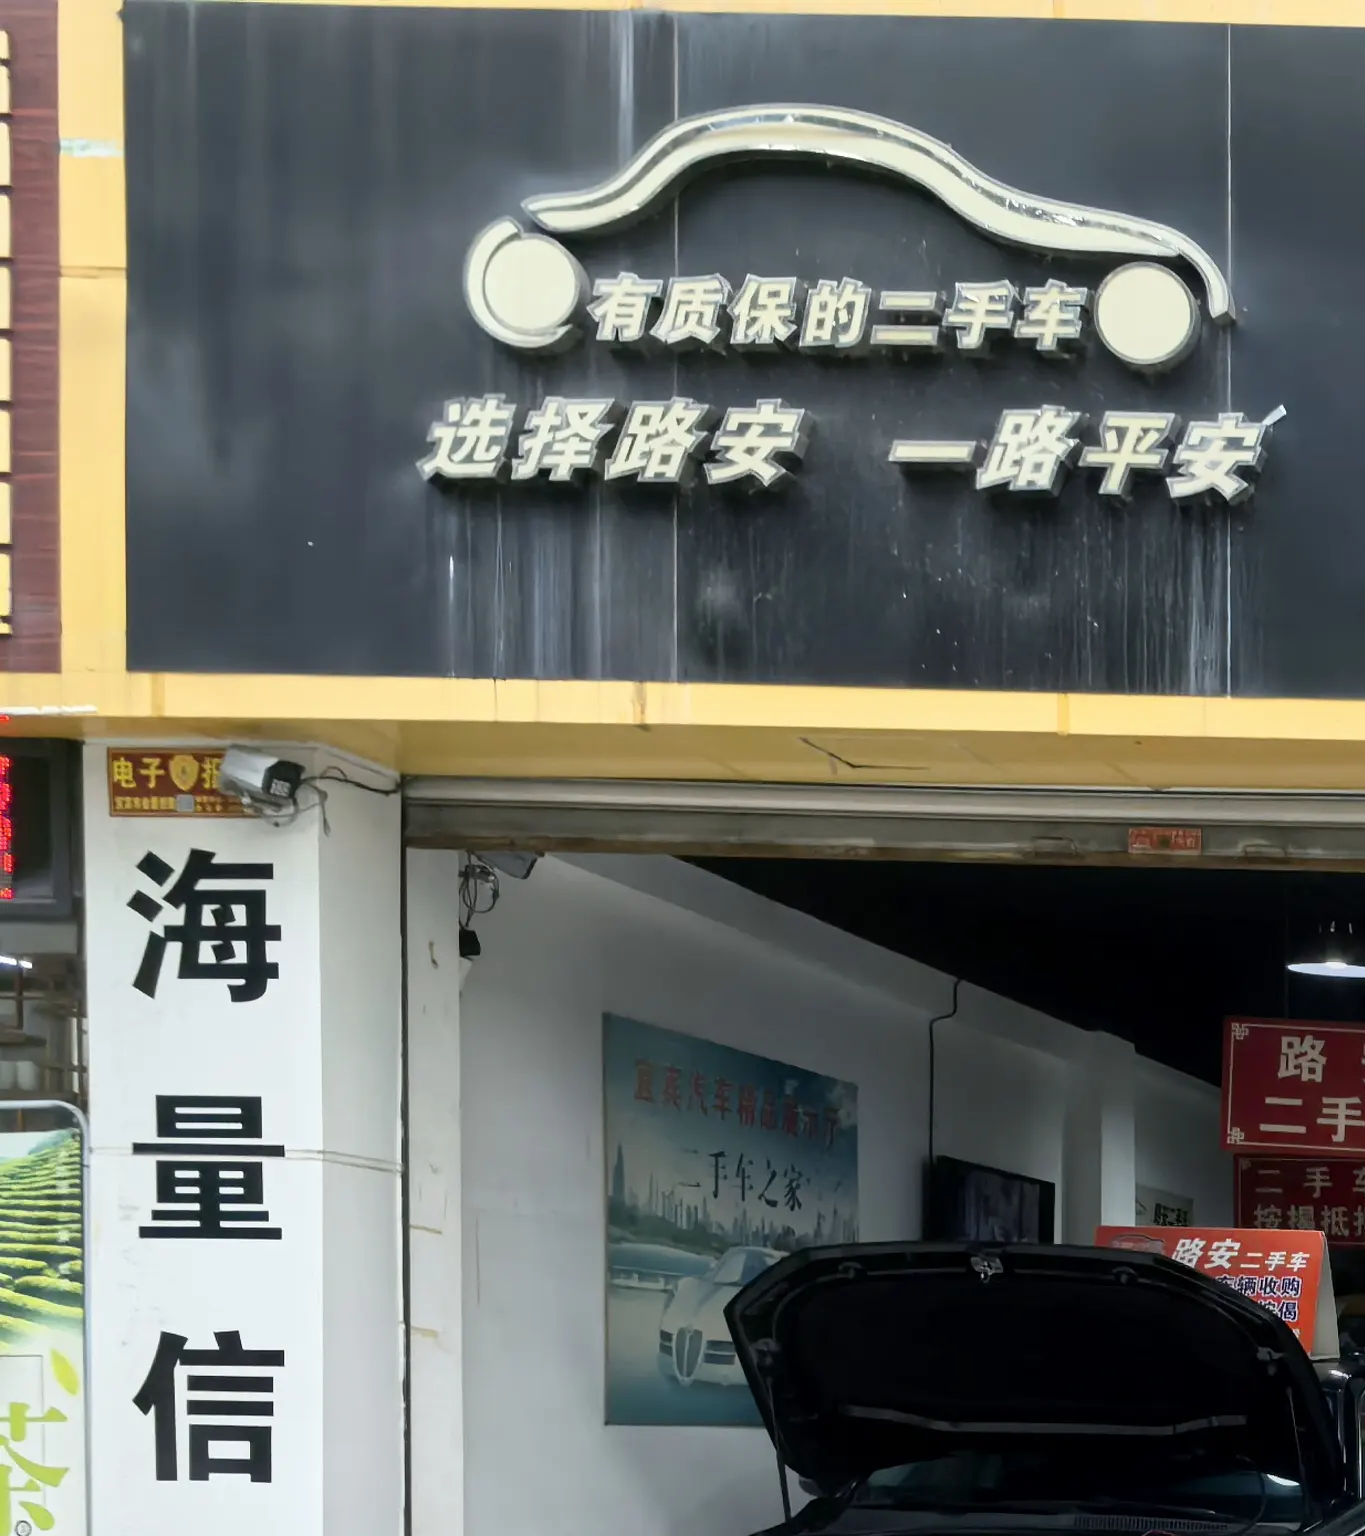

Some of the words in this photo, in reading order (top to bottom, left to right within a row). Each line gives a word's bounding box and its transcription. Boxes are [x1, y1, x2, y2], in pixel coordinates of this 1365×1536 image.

[588, 271, 1094, 356] 有质保的二手车
[418, 394, 815, 489] 选择路安
[888, 405, 1280, 503] 一路平安
[113, 757, 166, 788] 电子
[1171, 1237, 1311, 1272] 路安二手车
